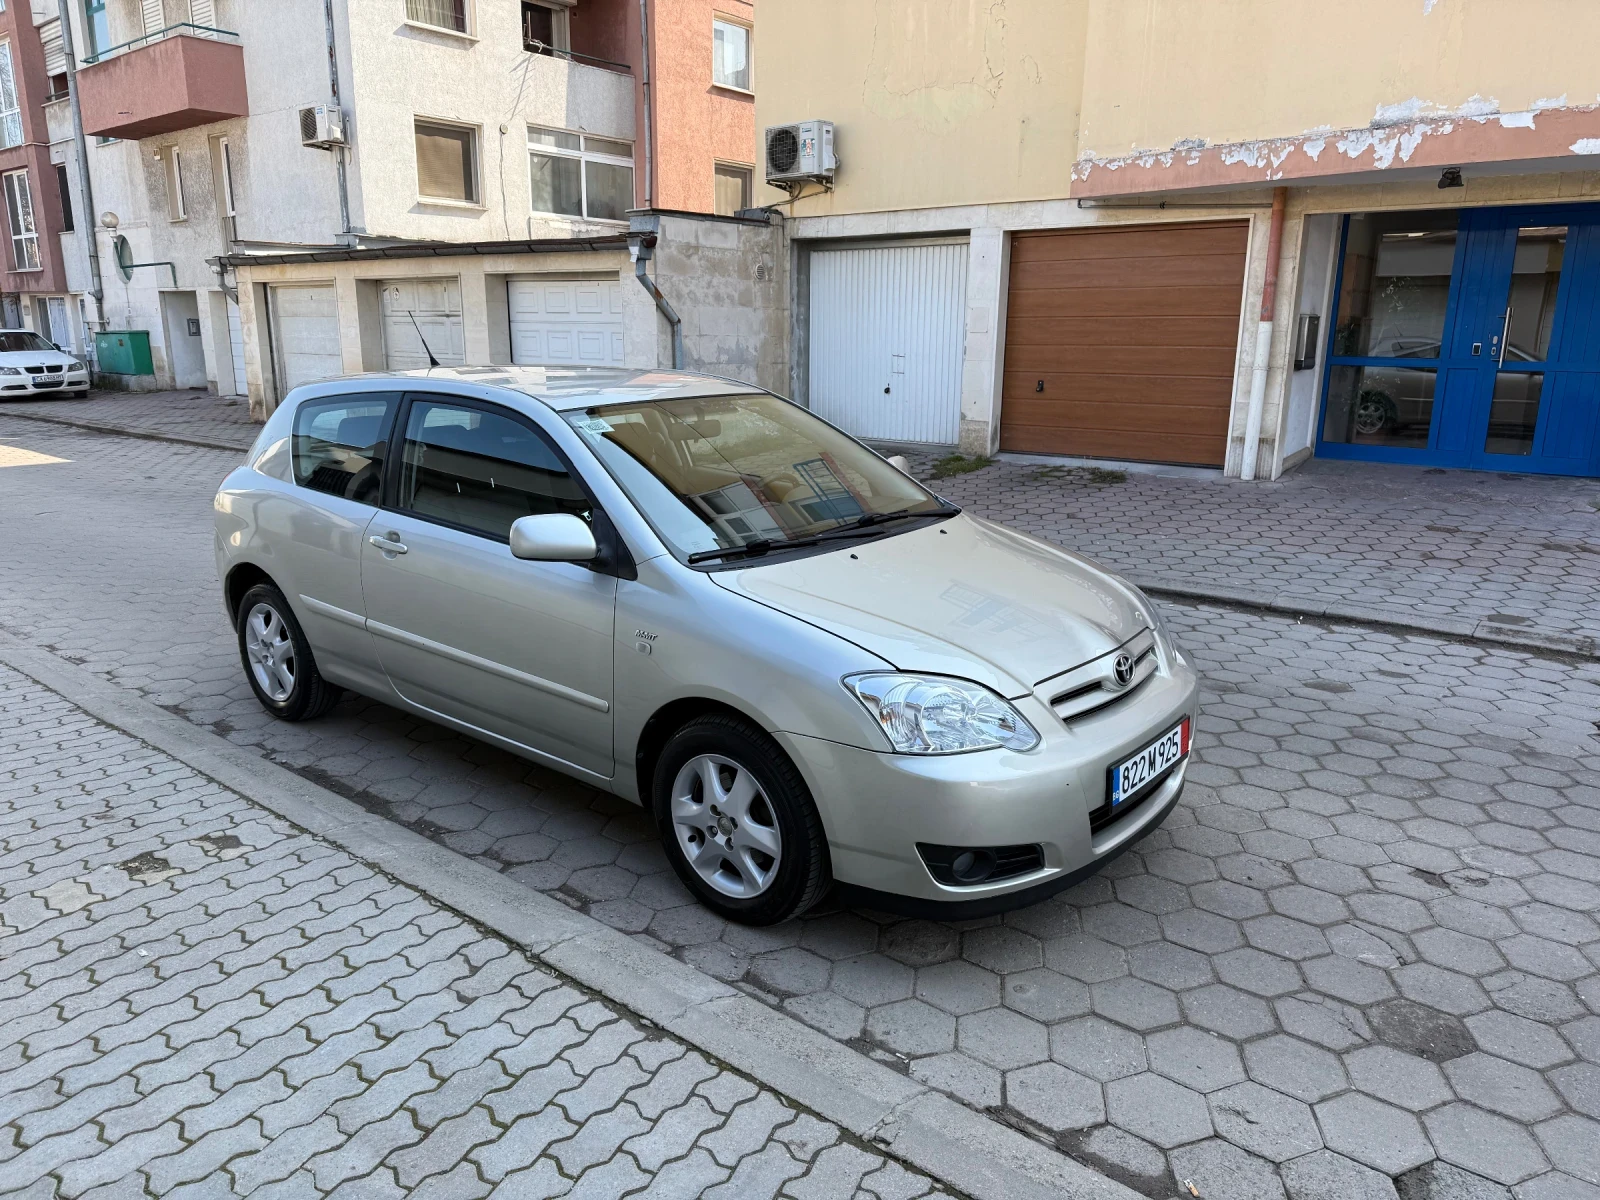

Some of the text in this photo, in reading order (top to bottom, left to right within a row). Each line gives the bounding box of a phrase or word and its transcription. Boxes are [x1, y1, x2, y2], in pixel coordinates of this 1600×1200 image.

[1122, 730, 1179, 794] 822 M 925
